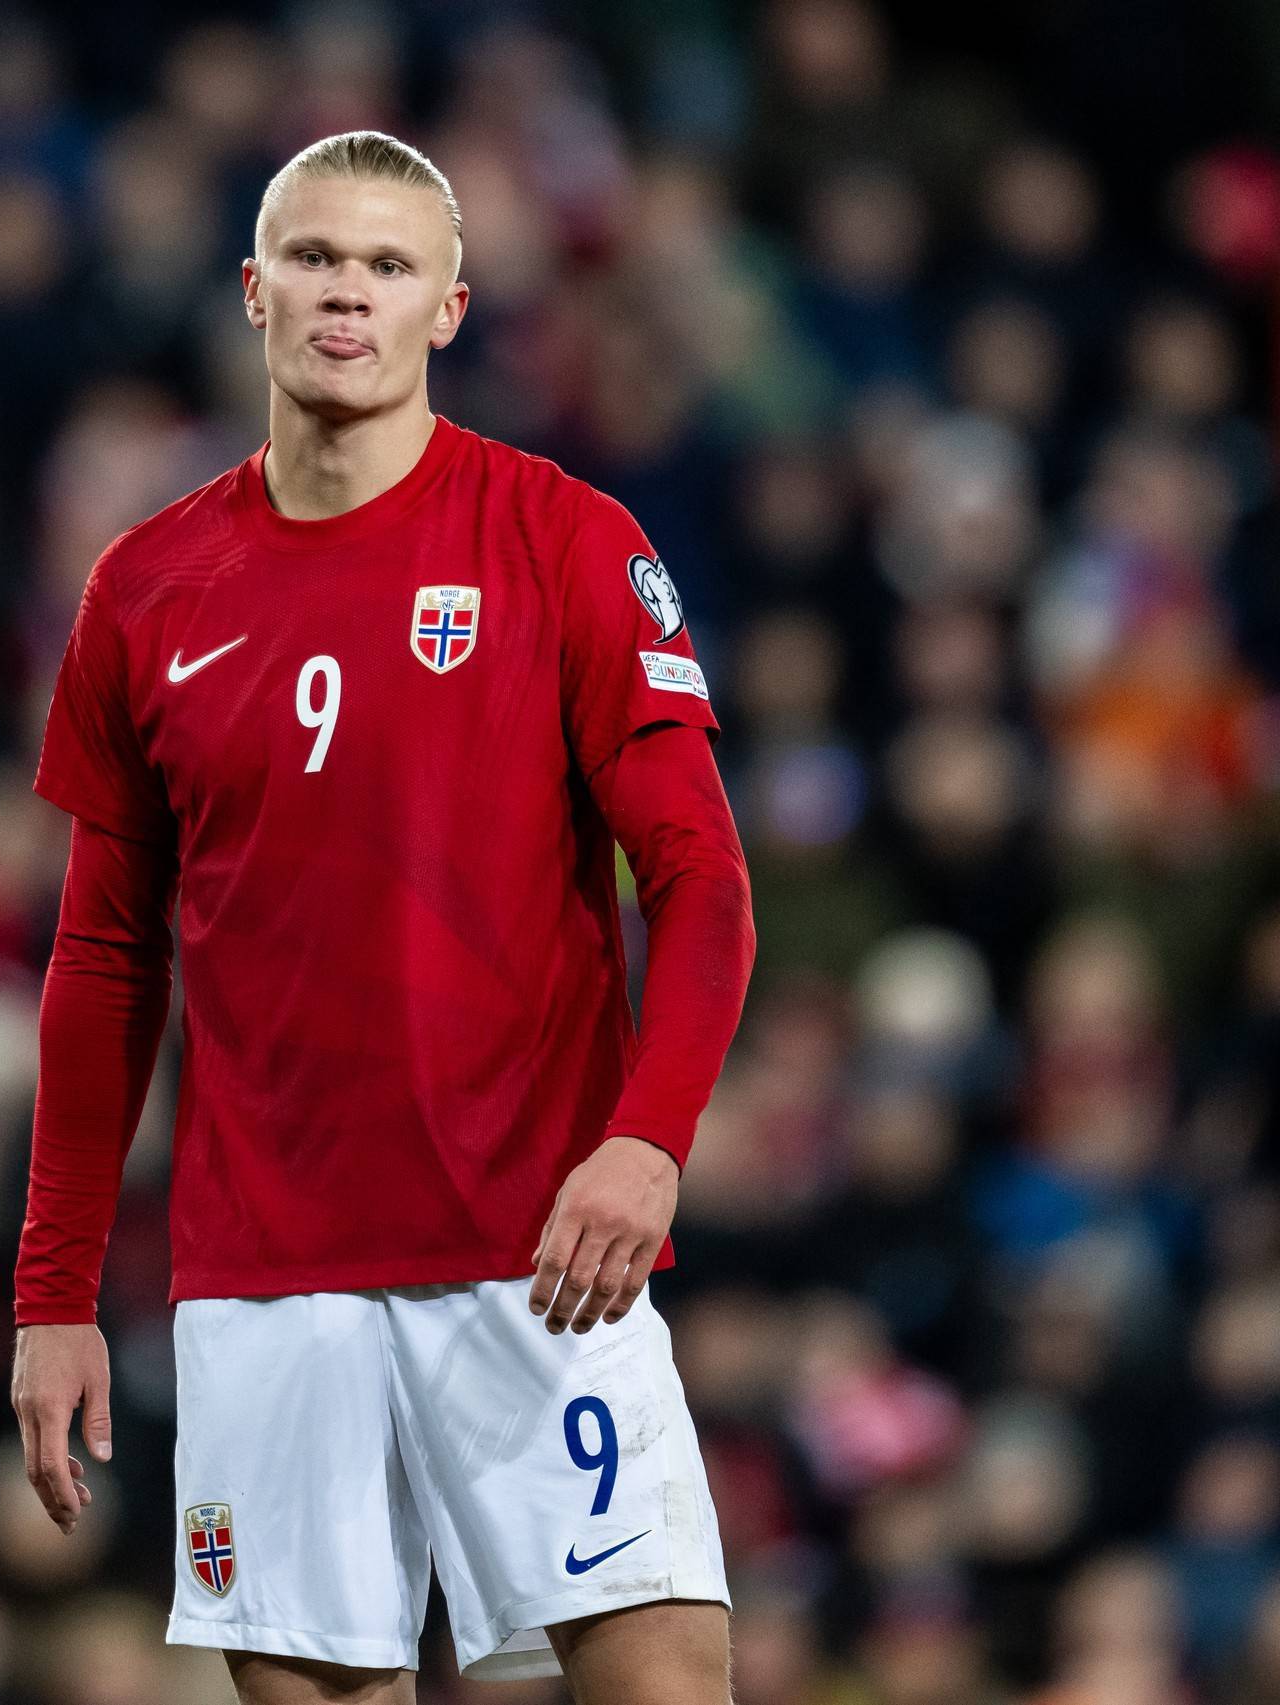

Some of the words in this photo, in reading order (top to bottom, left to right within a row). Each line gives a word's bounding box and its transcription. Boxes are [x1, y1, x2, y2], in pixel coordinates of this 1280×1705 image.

[440, 590, 460, 598] NORGE
[642, 654, 660, 662] UEFA
[296, 654, 341, 773] 9
[563, 1395, 618, 1516] 9
[200, 1507, 216, 1517] NORGE
